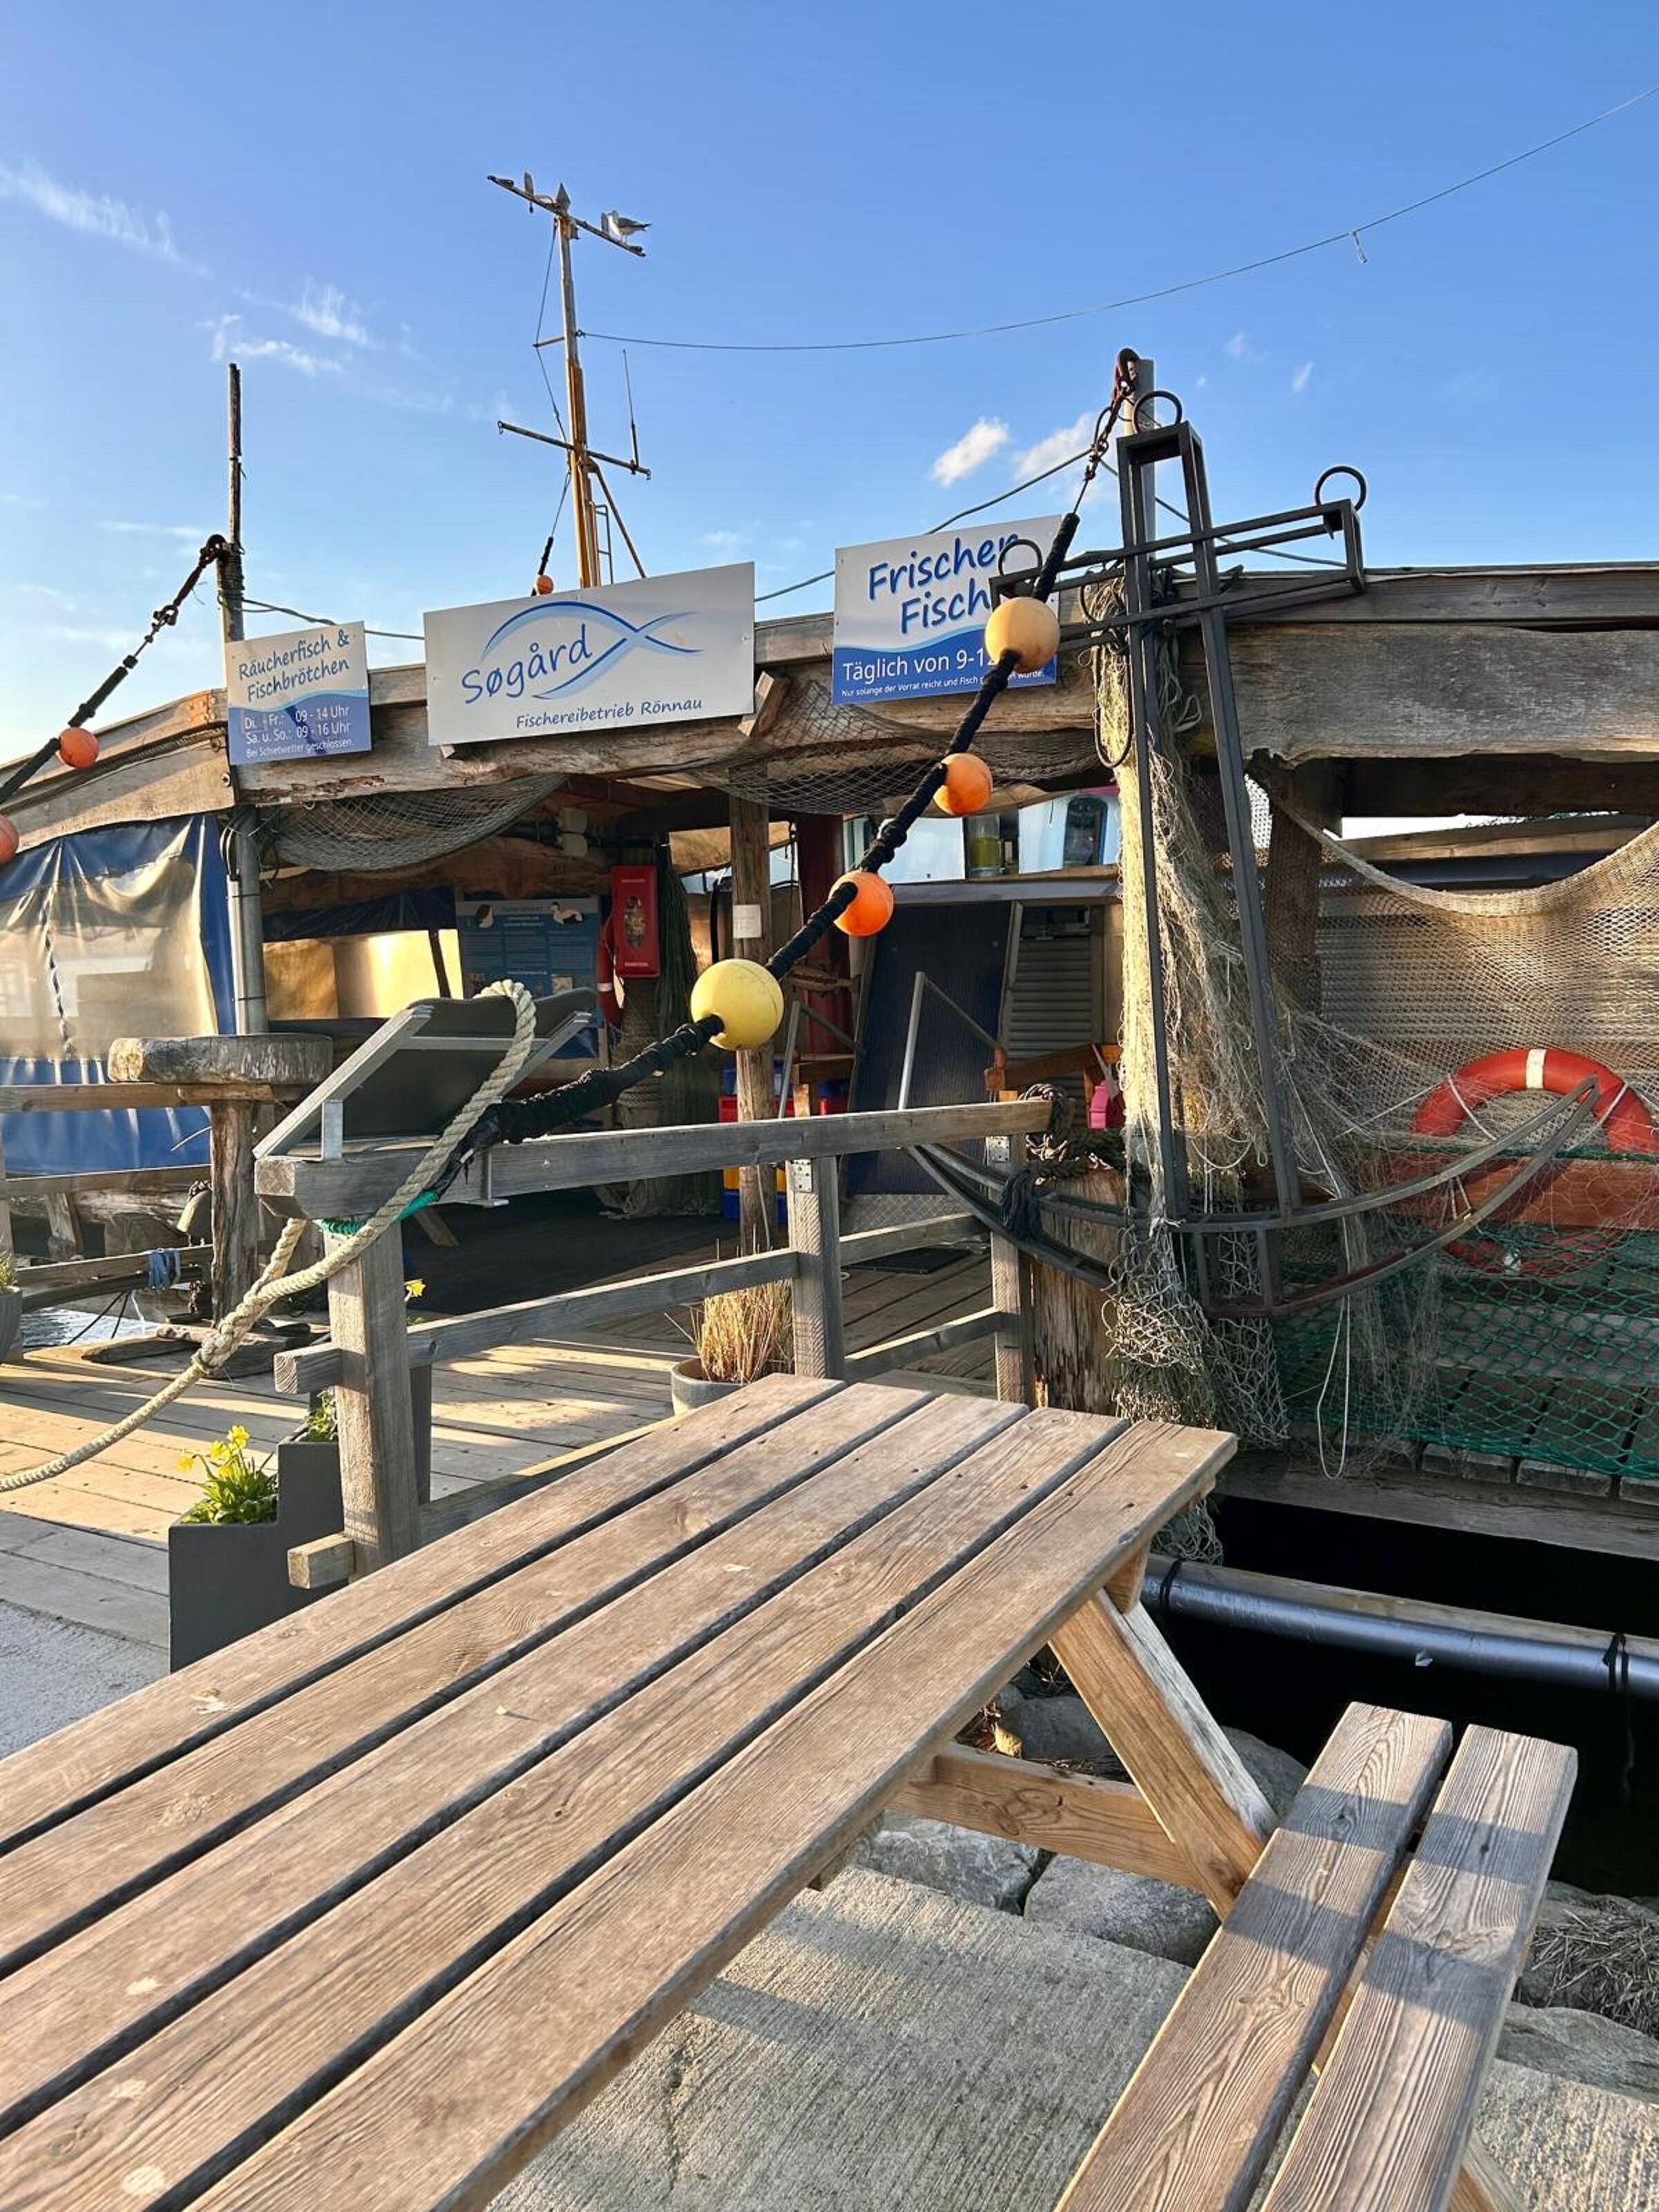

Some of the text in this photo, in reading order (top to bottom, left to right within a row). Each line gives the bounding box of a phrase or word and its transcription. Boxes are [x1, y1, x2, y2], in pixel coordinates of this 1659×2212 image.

[869, 534, 1018, 600] Frischer
[901, 577, 991, 634] Fisch
[238, 629, 350, 680] Räucherfisch &
[461, 623, 592, 704] Søgård
[247, 659, 349, 702] Fischbrötchen
[843, 655, 908, 685] Täglich
[914, 655, 950, 674] von
[856, 686, 883, 696] solange
[898, 682, 920, 691] Vorrat
[921, 679, 942, 688] reicht
[944, 677, 958, 686] und
[959, 675, 978, 685] Fisch
[295, 709, 308, 722] 09
[317, 707, 328, 720] 14
[330, 704, 350, 718] Uhr
[516, 699, 702, 729] Fischereibetrieb Rönnau
[245, 732, 260, 744] Sa.
[262, 733, 271, 742] u.
[297, 726, 308, 738] 09
[318, 722, 329, 735] 16
[331, 721, 350, 734] Uhr
[306, 739, 355, 754] geschlossen.
